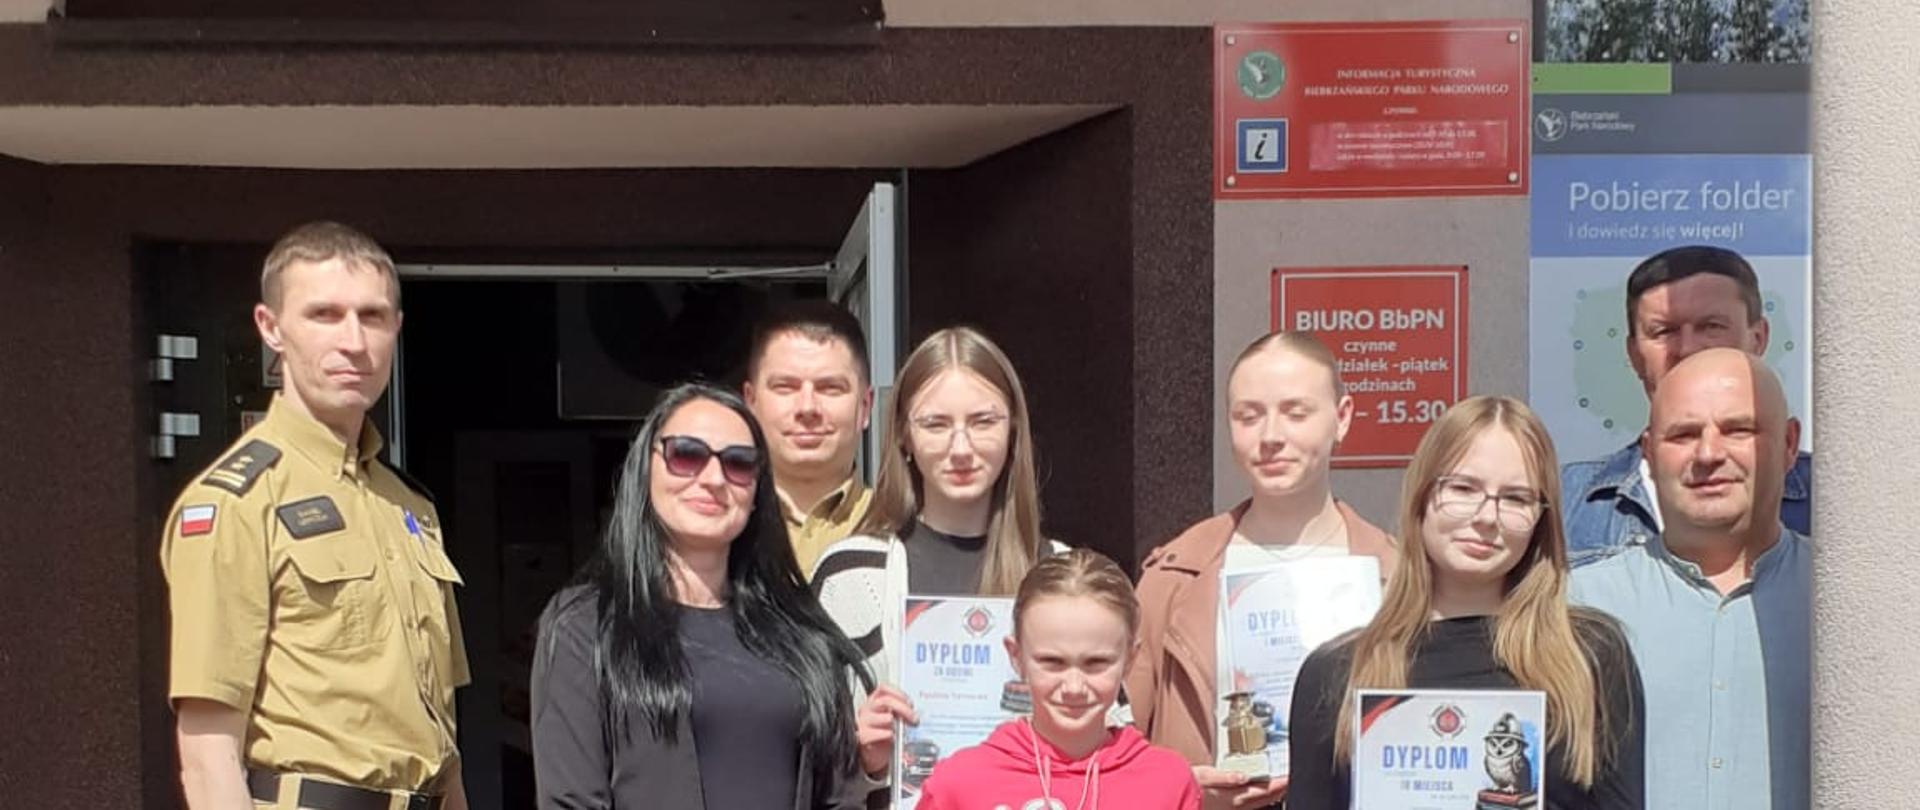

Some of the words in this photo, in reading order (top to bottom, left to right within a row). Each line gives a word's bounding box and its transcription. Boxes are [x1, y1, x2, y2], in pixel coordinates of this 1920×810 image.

[1337, 68, 1401, 80] INFORMACJA
[1406, 68, 1477, 79] TURYSTYCZNA
[1393, 84, 1427, 96] PARKU
[1431, 84, 1509, 95] NARODOWEGO
[1569, 181, 1691, 211] Pobierz
[1701, 180, 1794, 210] folder
[1577, 222, 1648, 239] dowiedz
[1652, 222, 1676, 240] się
[1679, 222, 1744, 241] więcej!
[1296, 310, 1374, 330] BIURO
[1380, 309, 1445, 329] BbPN
[1343, 340, 1397, 354] czynne
[1377, 400, 1447, 423] 15.30
[916, 642, 991, 664] DYPLOM
[1382, 745, 1468, 769] DYPLOM
